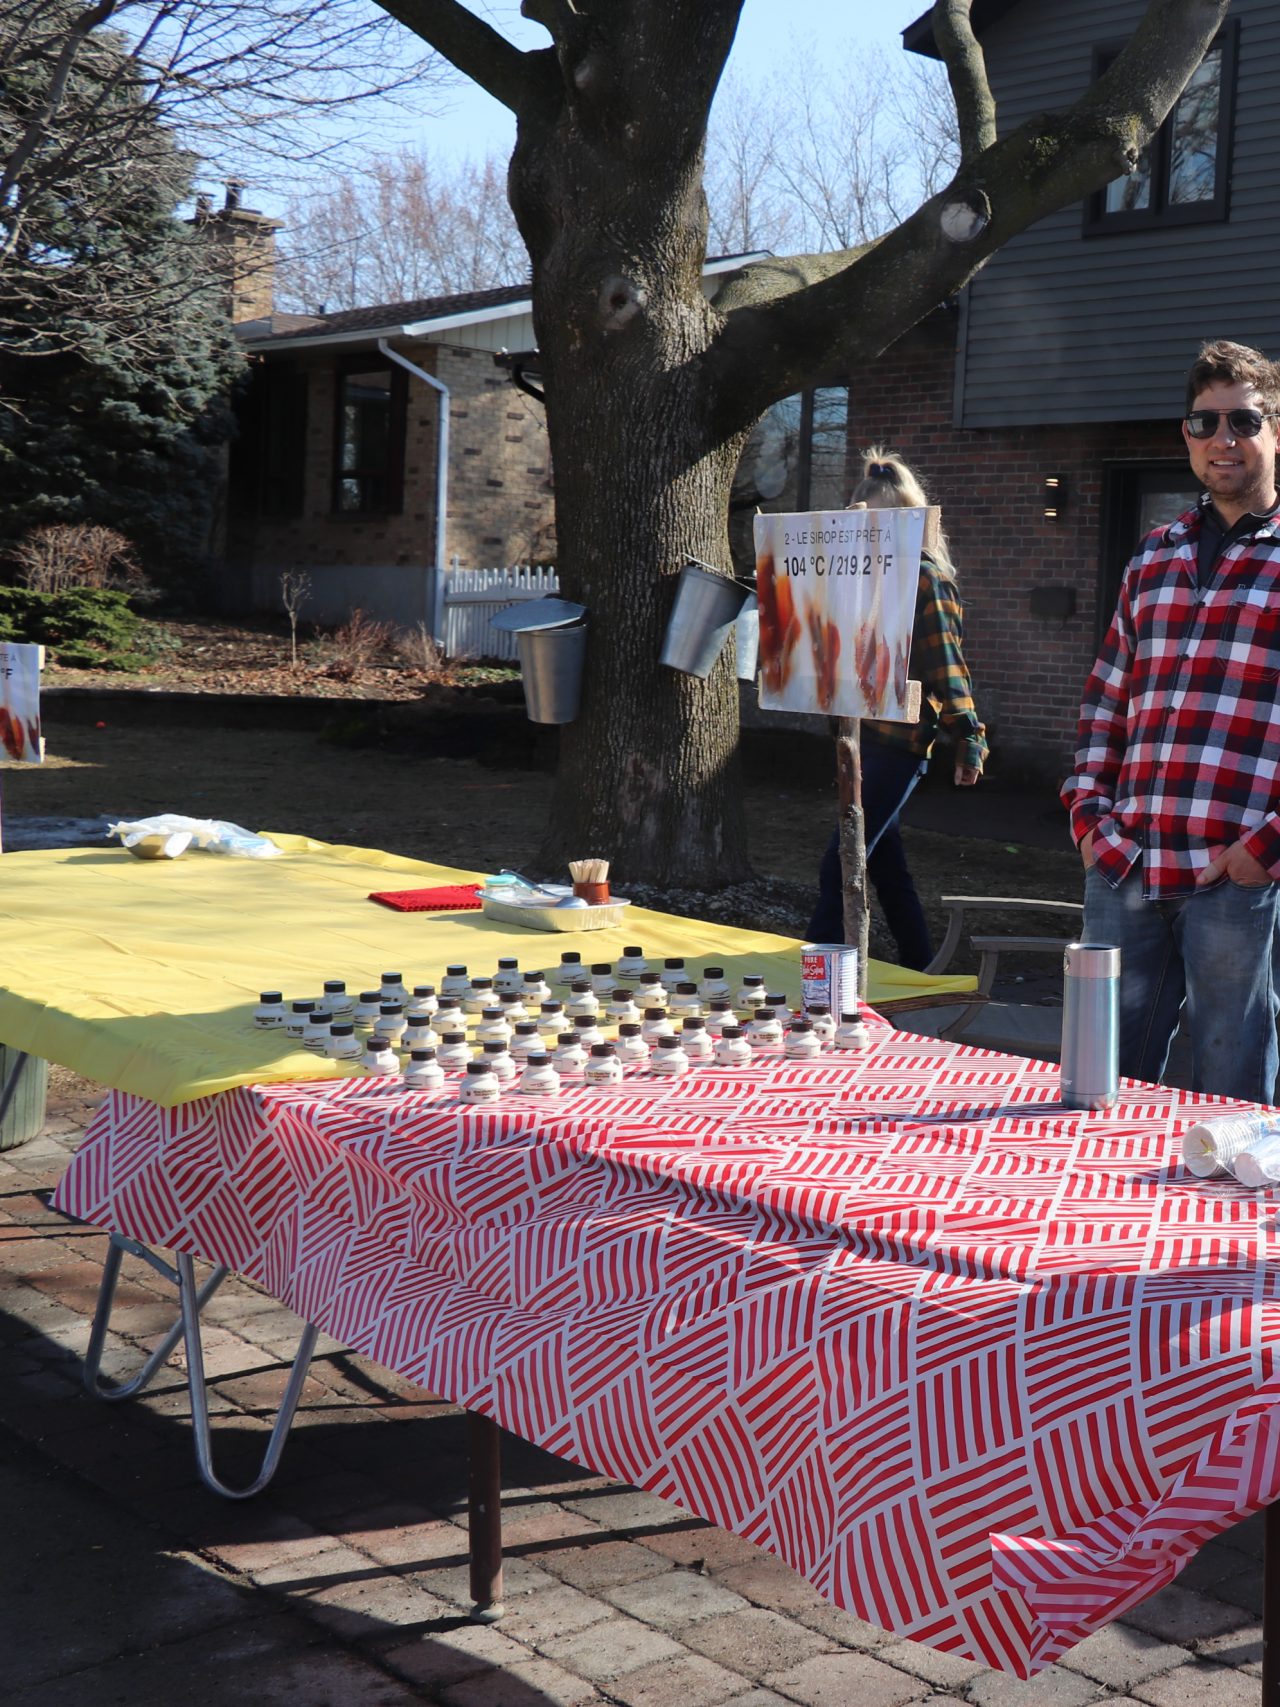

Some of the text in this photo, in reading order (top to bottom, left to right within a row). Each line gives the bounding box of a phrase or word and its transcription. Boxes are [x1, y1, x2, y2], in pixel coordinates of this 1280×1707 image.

[784, 532, 790, 545] 2
[796, 531, 808, 545] LE
[810, 530, 837, 544] SIROP
[839, 529, 854, 544] EST
[856, 526, 883, 543] PRÊT
[783, 556, 806, 577] 104
